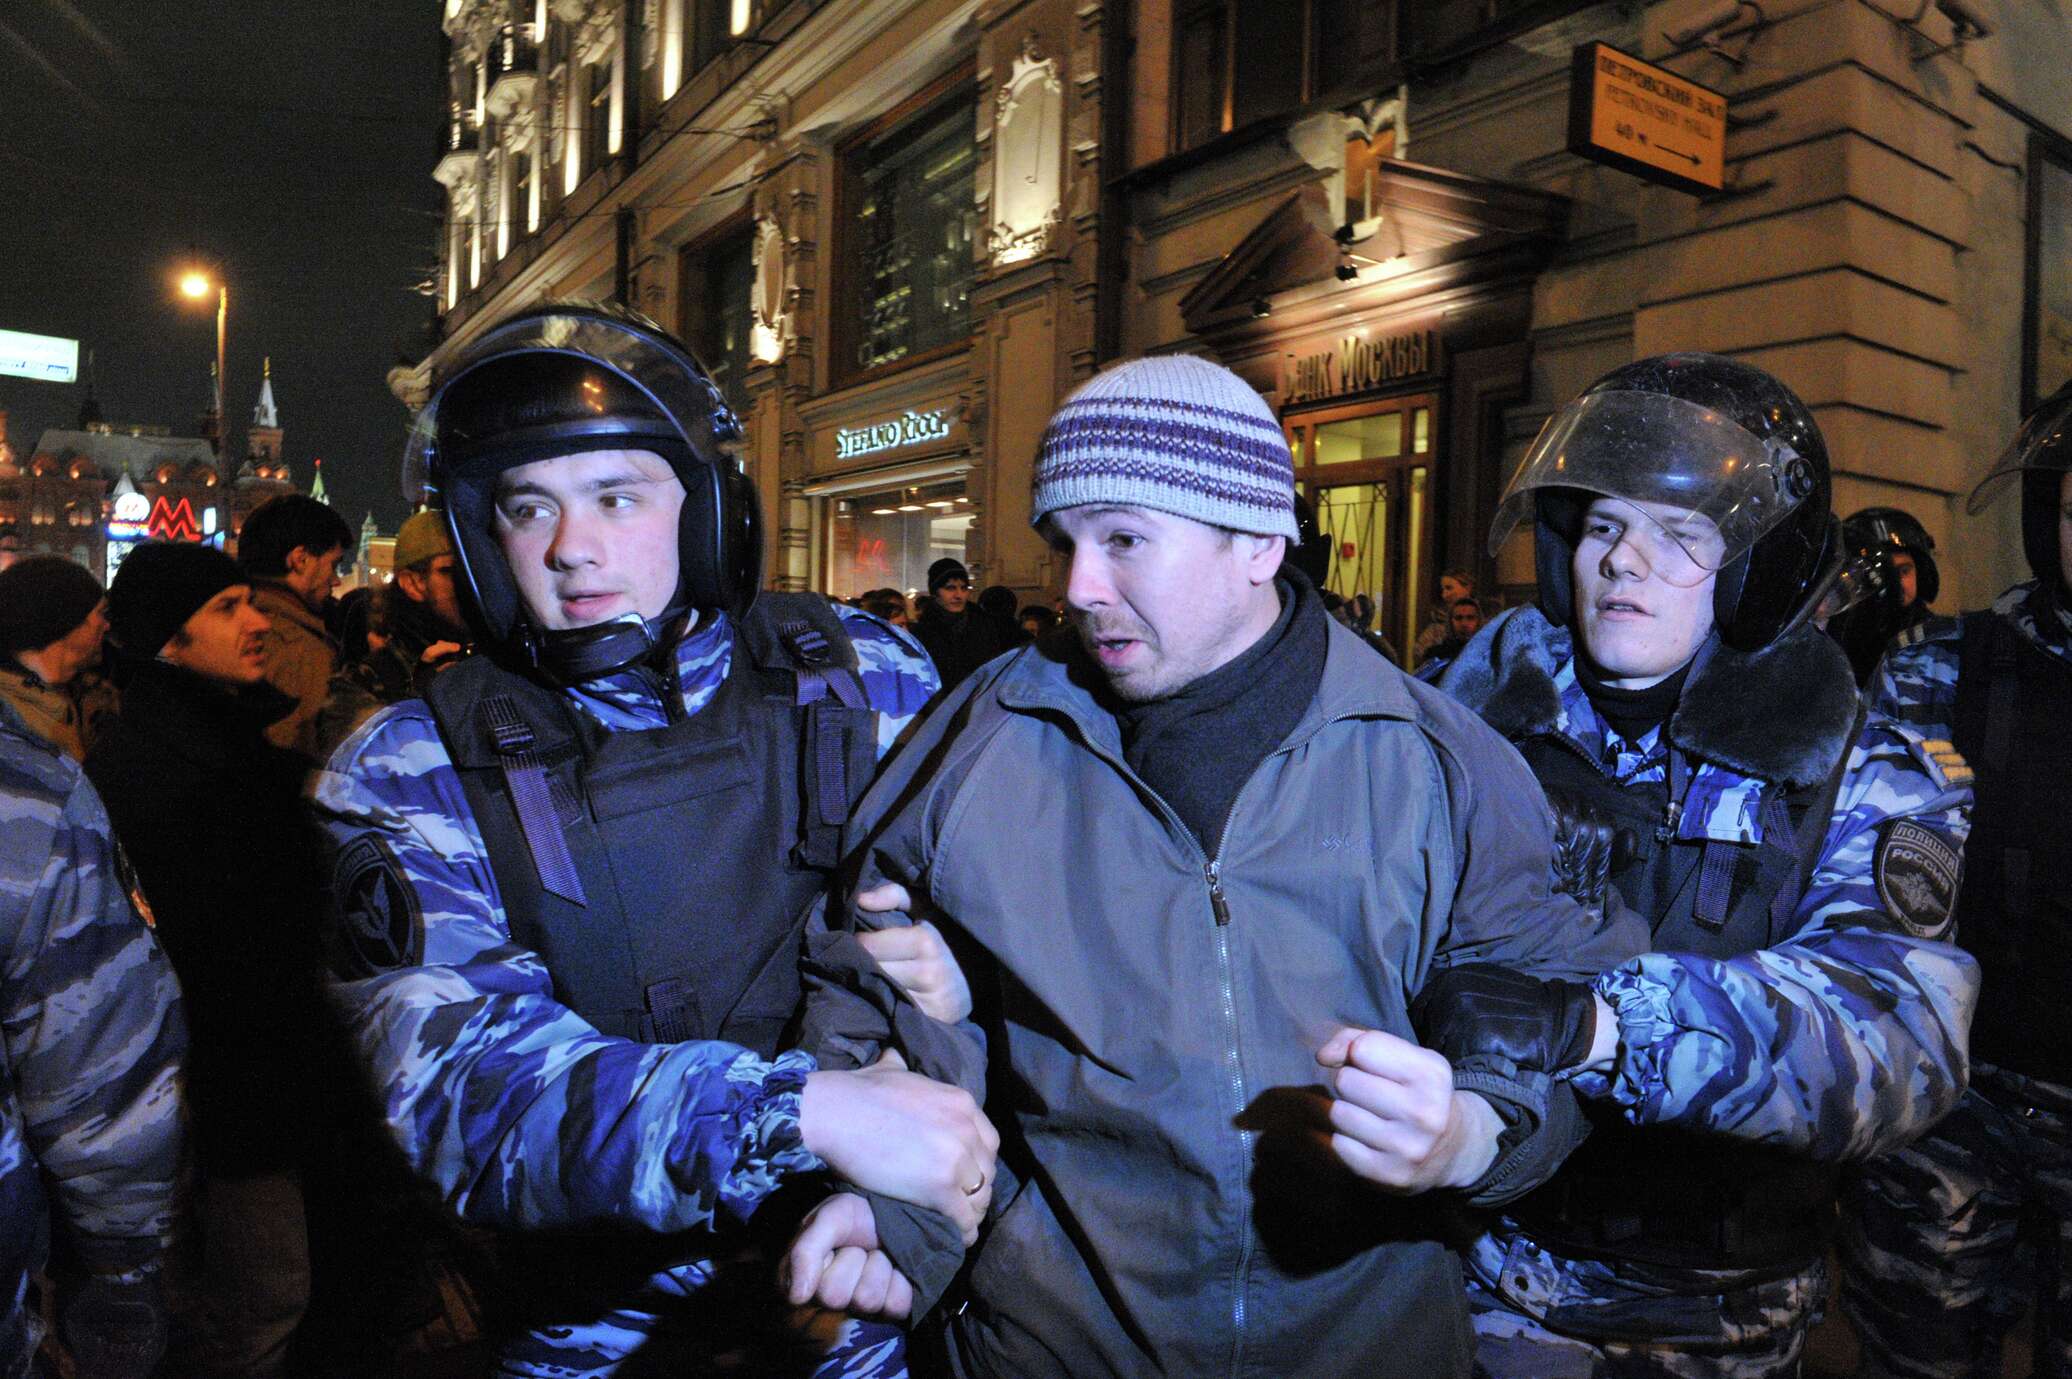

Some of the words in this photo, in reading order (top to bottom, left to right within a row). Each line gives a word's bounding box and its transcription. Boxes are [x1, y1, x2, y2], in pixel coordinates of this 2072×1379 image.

[1337, 330, 1432, 394] МОСКВЫ
[1891, 847, 1952, 896] РОССИЯ
[1897, 826, 1957, 873] ПОЛИЦИЯ
